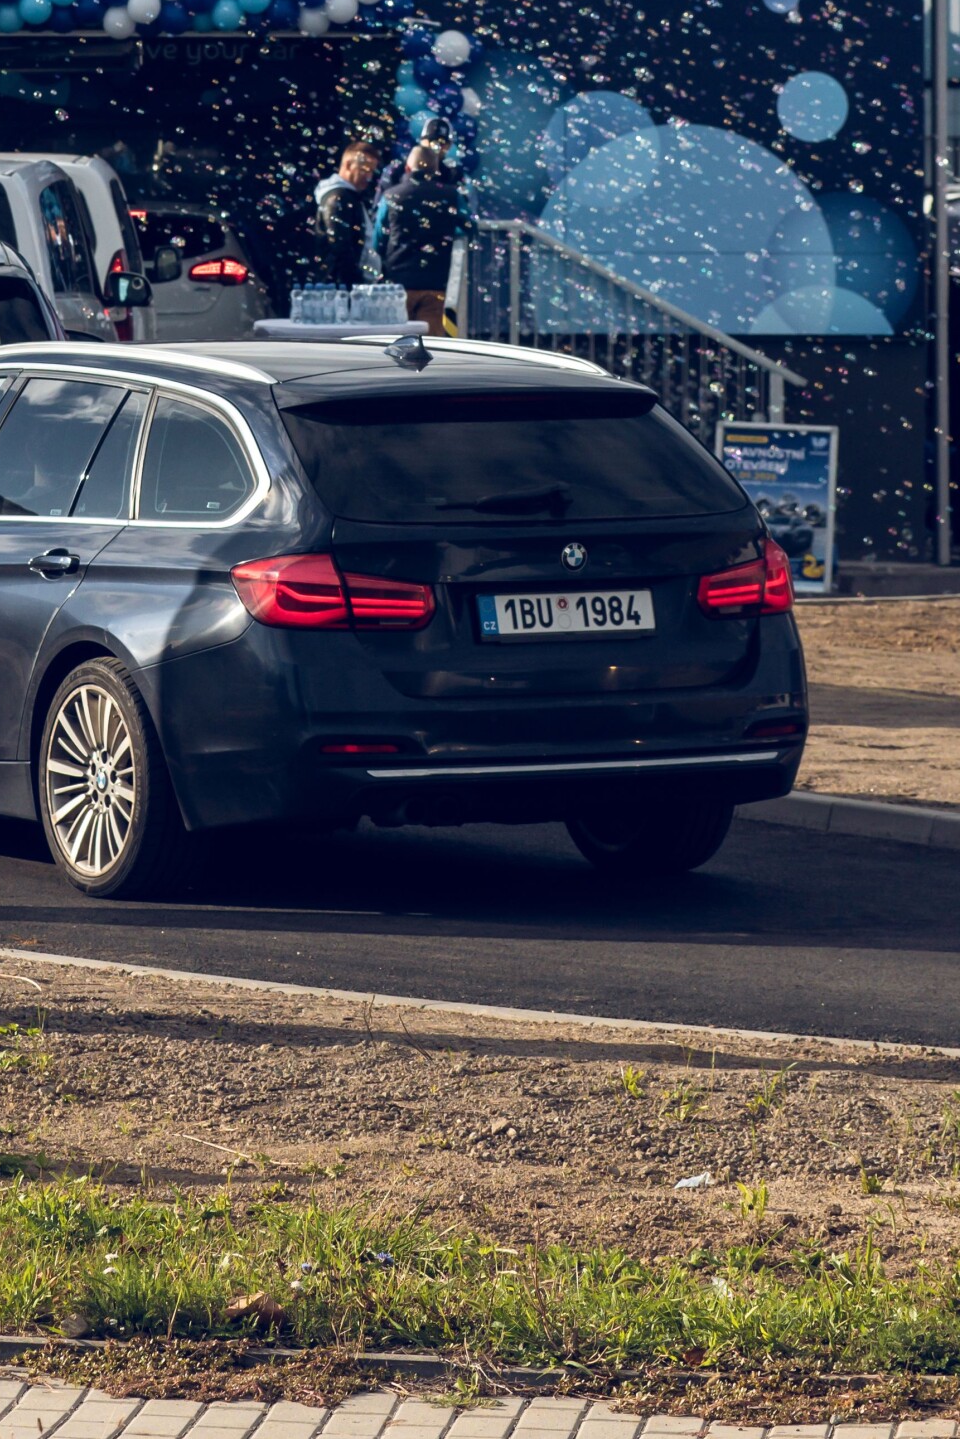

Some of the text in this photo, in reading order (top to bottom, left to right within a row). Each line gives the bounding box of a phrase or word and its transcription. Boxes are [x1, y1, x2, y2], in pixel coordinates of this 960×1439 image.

[504, 594, 642, 630] 1BU 1984
[483, 621, 497, 631] CZ
